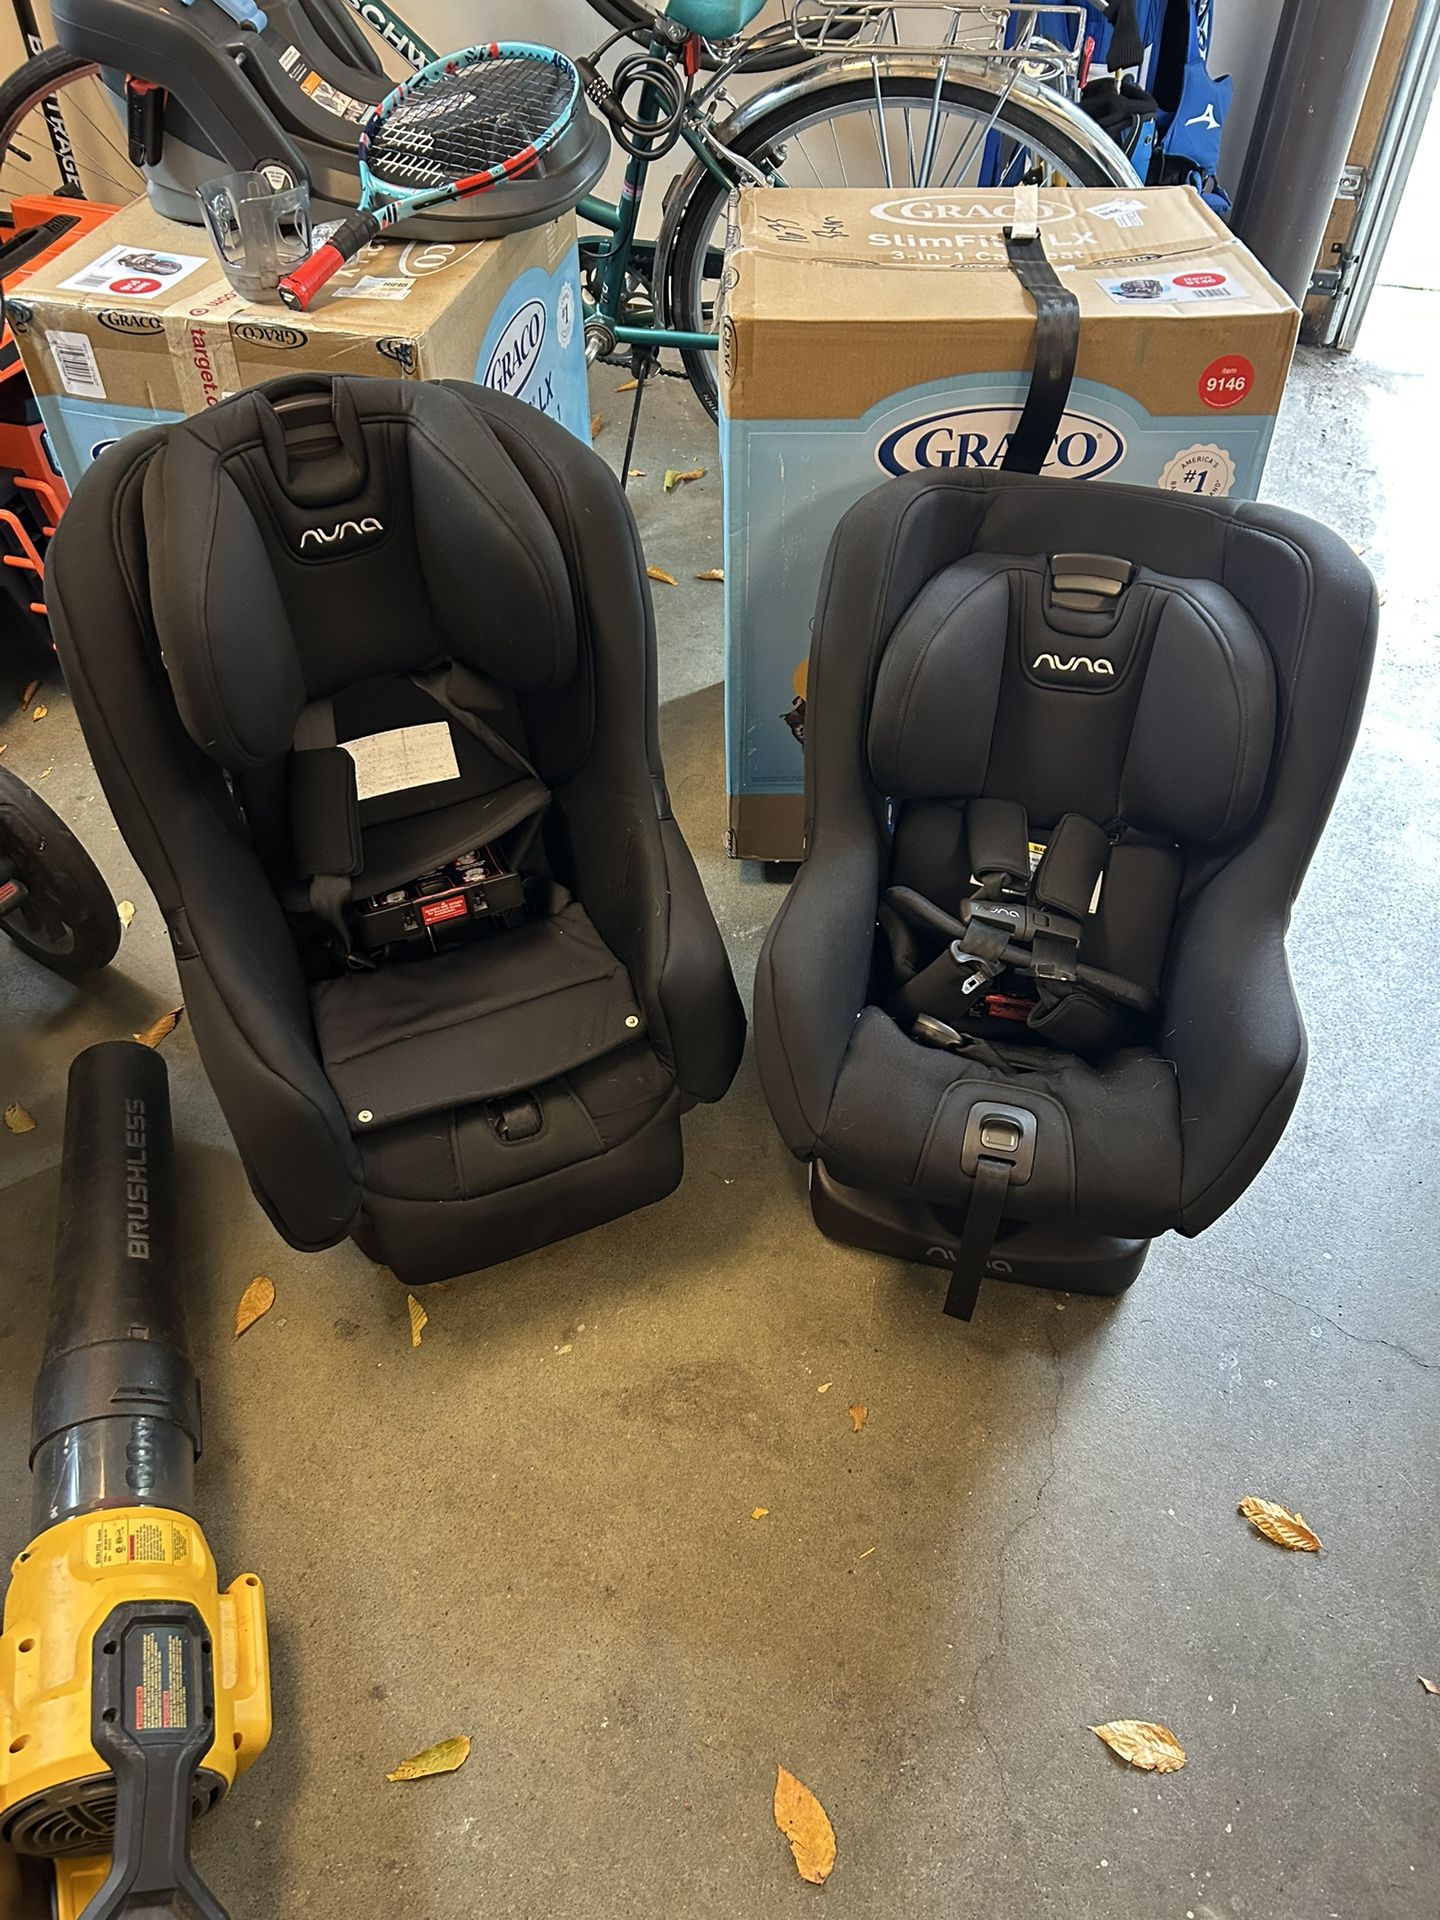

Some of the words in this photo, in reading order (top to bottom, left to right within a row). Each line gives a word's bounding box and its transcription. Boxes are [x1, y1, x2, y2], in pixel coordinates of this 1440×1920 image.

[1050, 232, 1099, 246] LX
[892, 250, 964, 262] 3-in-1
[975, 251, 1007, 262] Ca
[1042, 250, 1084, 261] eat
[107, 311, 161, 329] GRACO
[240, 326, 298, 346] GRACO
[1206, 376, 1246, 392] 9146
[1180, 455, 1220, 470] AMERICA'S
[1183, 469, 1209, 493] #1
[299, 518, 384, 549] nuna
[1031, 653, 1116, 676] nuna
[126, 1098, 150, 1260] BRUSHLESS
